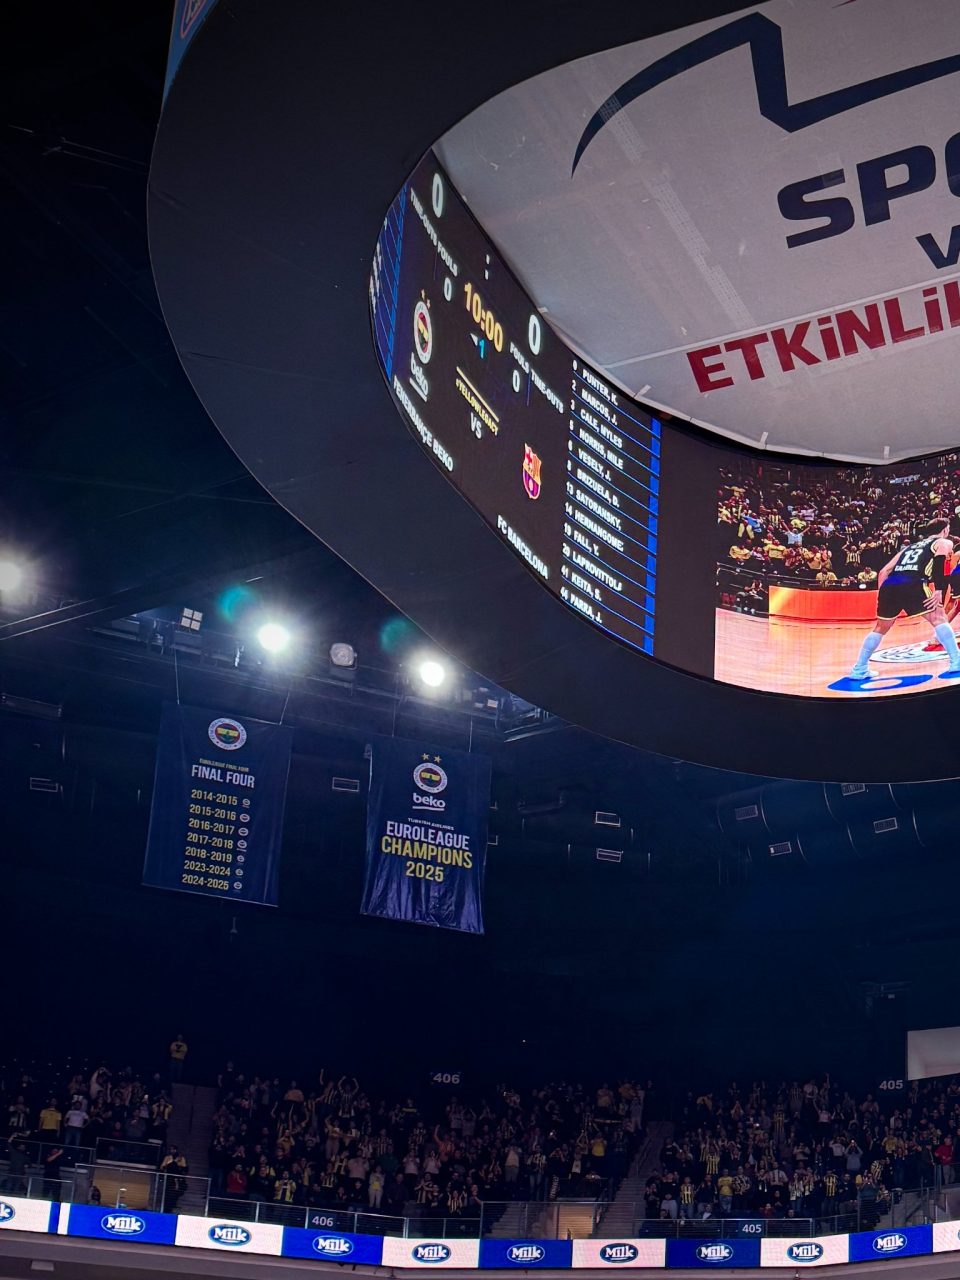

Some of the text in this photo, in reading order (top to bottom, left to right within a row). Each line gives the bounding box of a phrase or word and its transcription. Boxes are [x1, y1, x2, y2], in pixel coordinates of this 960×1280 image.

[432, 173, 444, 218] 0
[410, 187, 458, 276] TIME-OUTS FOULS
[444, 277, 452, 301] 0
[464, 282, 504, 352] 10:00
[528, 314, 542, 356] 0
[478, 340, 484, 358] 1
[410, 352, 428, 396] beko
[510, 342, 564, 414] FOULS TIME-OUTS
[512, 370, 520, 392] 0
[582, 369, 610, 400] PUNTER,
[571, 380, 576, 391] 2
[582, 389, 610, 420] MARCOS,
[470, 412, 482, 439] VS
[580, 408, 600, 432] CALE,
[600, 424, 622, 448] MYLES
[432, 437, 454, 472] BEKO
[580, 428, 606, 458] NORRIS,
[606, 450, 624, 470] MILE
[578, 448, 604, 478] VESELY,
[576, 468, 612, 504] BRIZUELA,
[565, 502, 572, 516] 14
[566, 482, 622, 530] 13 SATORANSKY,
[497, 515, 549, 580] FC BARCELONA
[574, 530, 592, 552] FALL,
[572, 572, 594, 598] KEITA,
[570, 594, 594, 620] PARRA,
[191, 764, 254, 788] FINAL FOUR
[191, 790, 238, 806] 2014-2015
[412, 792, 446, 808] beko
[190, 804, 236, 820] 2015-2016
[188, 818, 234, 834] 2016-2017
[386, 821, 470, 850] EUROLEAGUE
[187, 833, 233, 849] 2017-2018
[185, 848, 232, 864] 2018-2019
[382, 836, 472, 869] CHAMPIONS
[184, 860, 230, 876] 2023-2024
[406, 862, 444, 882] 2025
[182, 874, 228, 890] 2024-2025
[434, 1073, 460, 1085] 406
[880, 1080, 903, 1091] 405
[107, 1217, 141, 1230] Milk
[313, 1216, 333, 1227] 406
[742, 1224, 761, 1234] 405
[213, 1228, 248, 1242] Milk
[317, 1238, 350, 1252] Milk
[877, 1235, 903, 1250] Milk
[416, 1246, 448, 1259] Milk
[512, 1246, 541, 1258] Milk
[605, 1246, 634, 1258] Milk
[702, 1245, 729, 1258] Milk
[792, 1244, 819, 1257] Milk
